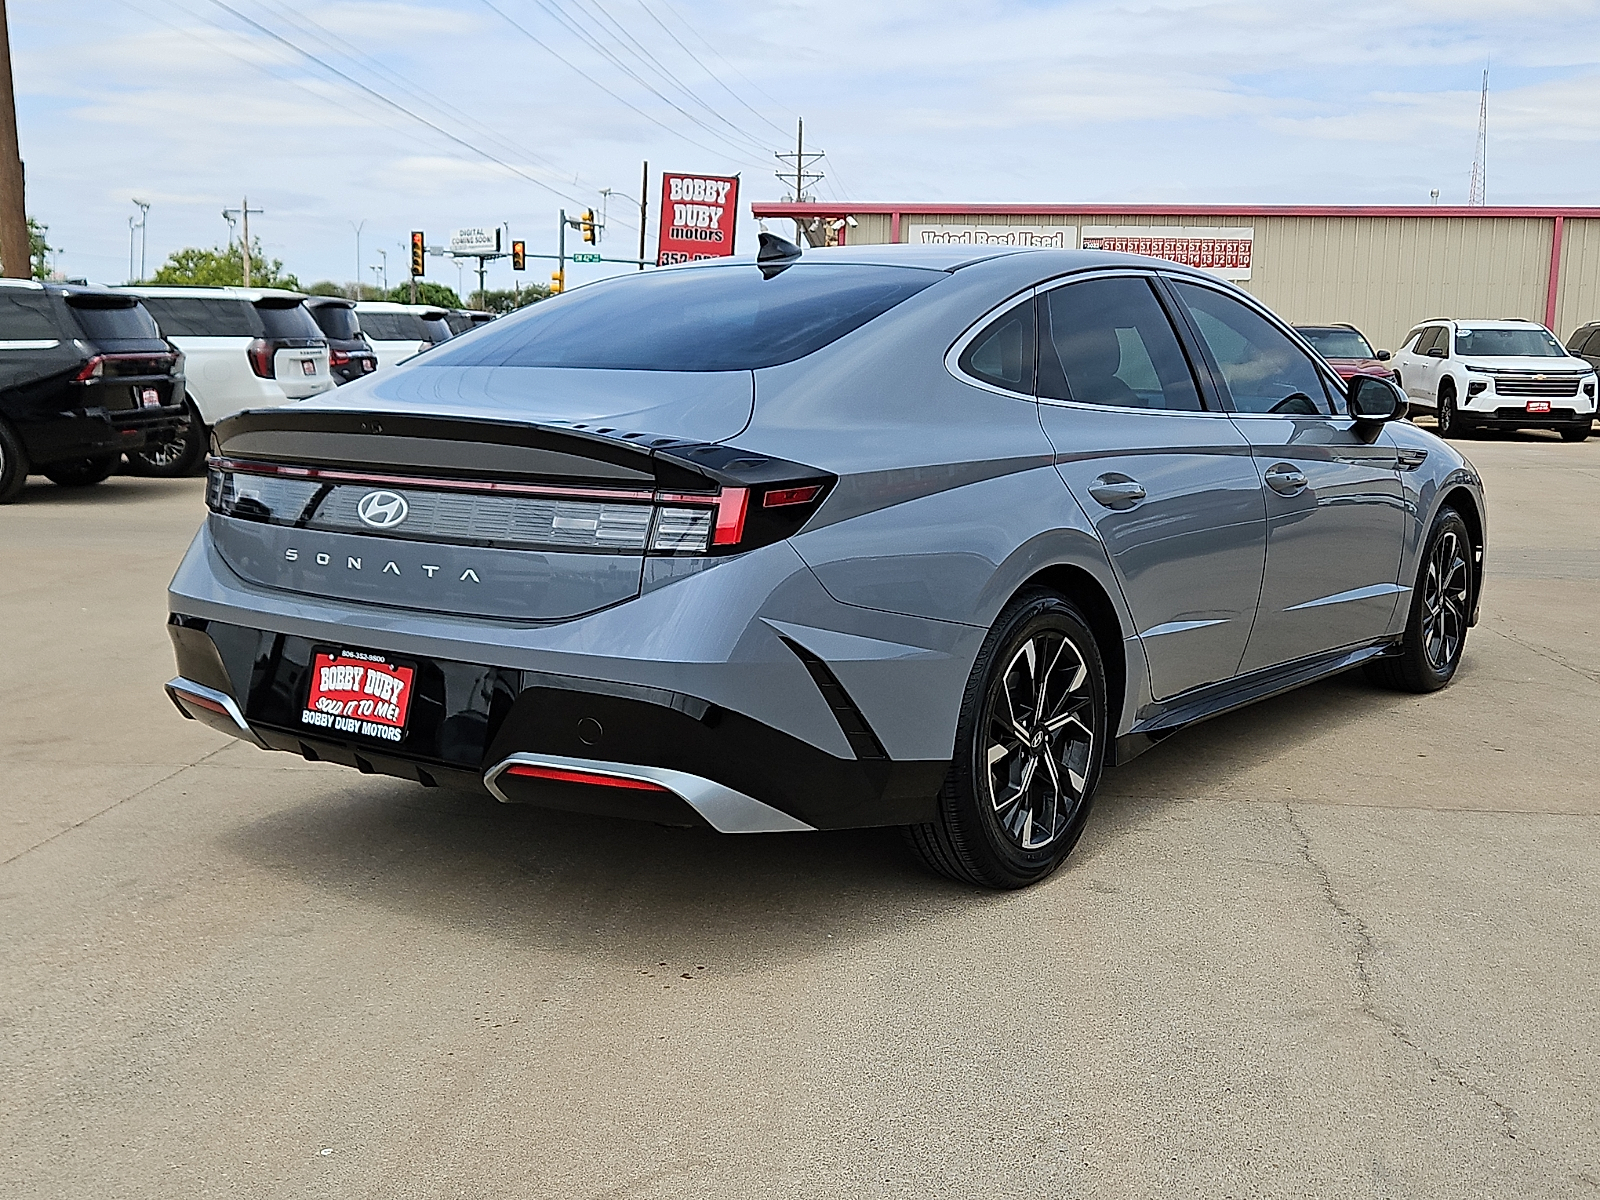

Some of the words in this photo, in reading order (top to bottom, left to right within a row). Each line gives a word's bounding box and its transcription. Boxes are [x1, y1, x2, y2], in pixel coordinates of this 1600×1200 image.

[669, 178, 731, 204] BOBBY
[673, 203, 724, 229] DUBY
[669, 227, 724, 242] motors
[1018, 232, 1063, 248] Used
[1189, 254, 1200, 263] 14
[1202, 254, 1213, 264] 13
[1215, 255, 1226, 264] 12
[1227, 255, 1237, 264] 11
[1240, 255, 1250, 265] 10
[285, 548, 480, 583] SONATA
[320, 665, 364, 692] BOBBY
[363, 668, 405, 704] DUBY
[315, 696, 343, 715] SOLD
[343, 700, 358, 716] IT
[357, 700, 374, 716] TO
[373, 700, 400, 722] ME!
[302, 710, 334, 728] BOBBY
[334, 716, 362, 734] DUBY
[361, 722, 402, 742] MOTORS
